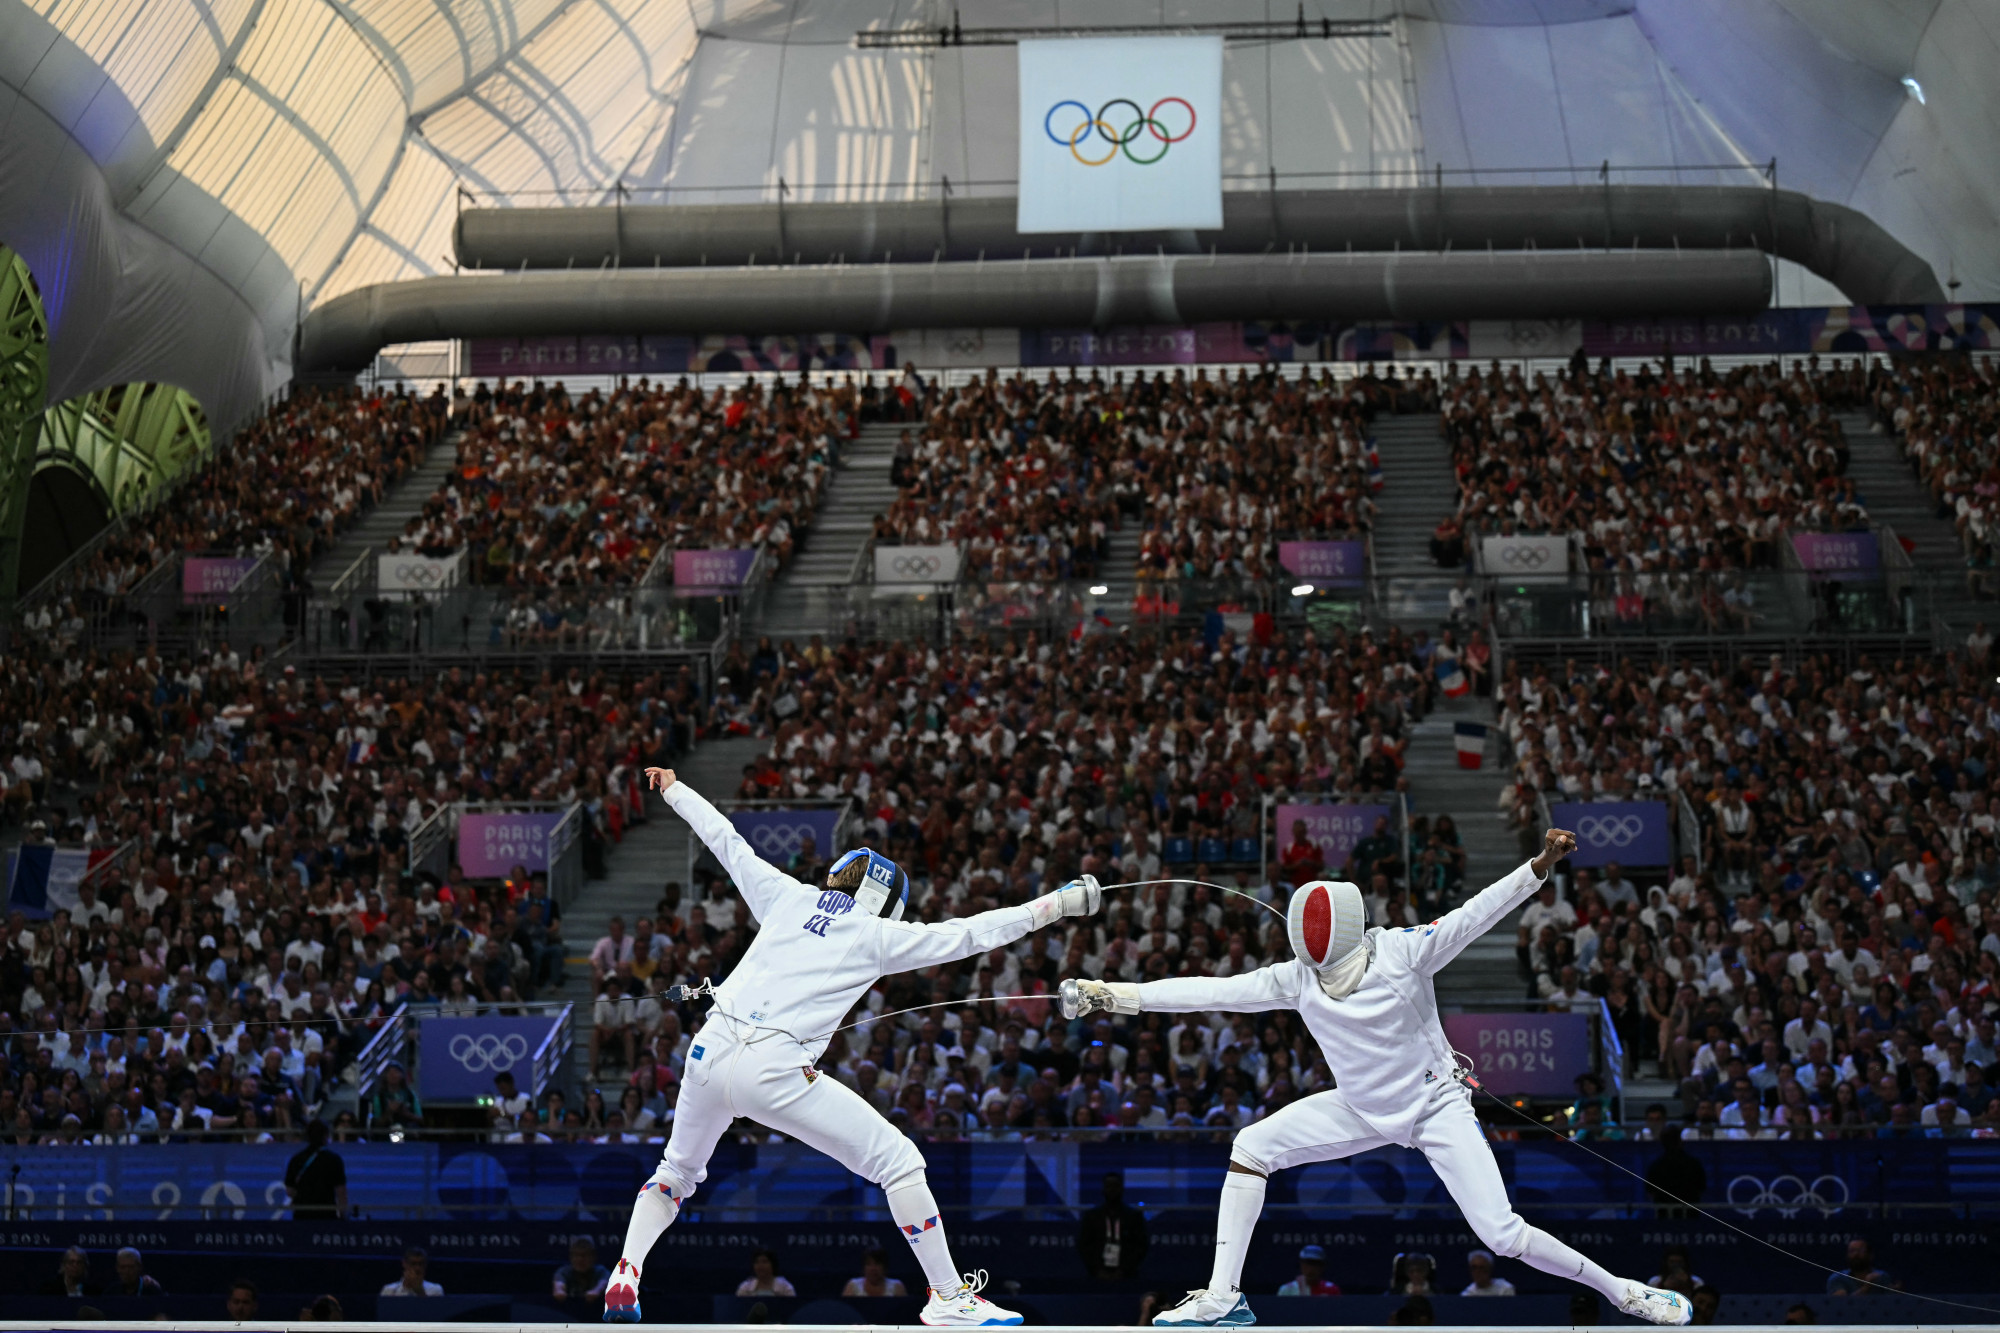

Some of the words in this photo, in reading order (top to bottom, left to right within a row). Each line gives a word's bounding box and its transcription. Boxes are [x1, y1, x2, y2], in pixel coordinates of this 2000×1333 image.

[1614, 325, 1695, 344] PARIS
[1705, 323, 1779, 343] 2024
[1051, 335, 1130, 354] PARIS
[1143, 334, 1211, 353] 2024
[501, 345, 577, 364] PARIS
[588, 344, 657, 363] 2024
[485, 824, 543, 842] PARIS
[1304, 815, 1363, 833] PARIS
[485, 842, 543, 860] 2024
[872, 863, 892, 886] CZE
[803, 914, 836, 937] CZE
[1478, 1029, 1554, 1049] PARIS
[1481, 1051, 1555, 1072] 2024
[78, 1232, 122, 1246] PARIS
[195, 1232, 239, 1246] PARIS
[312, 1233, 357, 1247] PARIS
[430, 1233, 475, 1247] PARIS
[1029, 1234, 1076, 1247] PARIS
[1642, 1232, 1689, 1244] PARIS
[1892, 1232, 1939, 1245] PARIS
[1945, 1232, 1988, 1245] 2024
